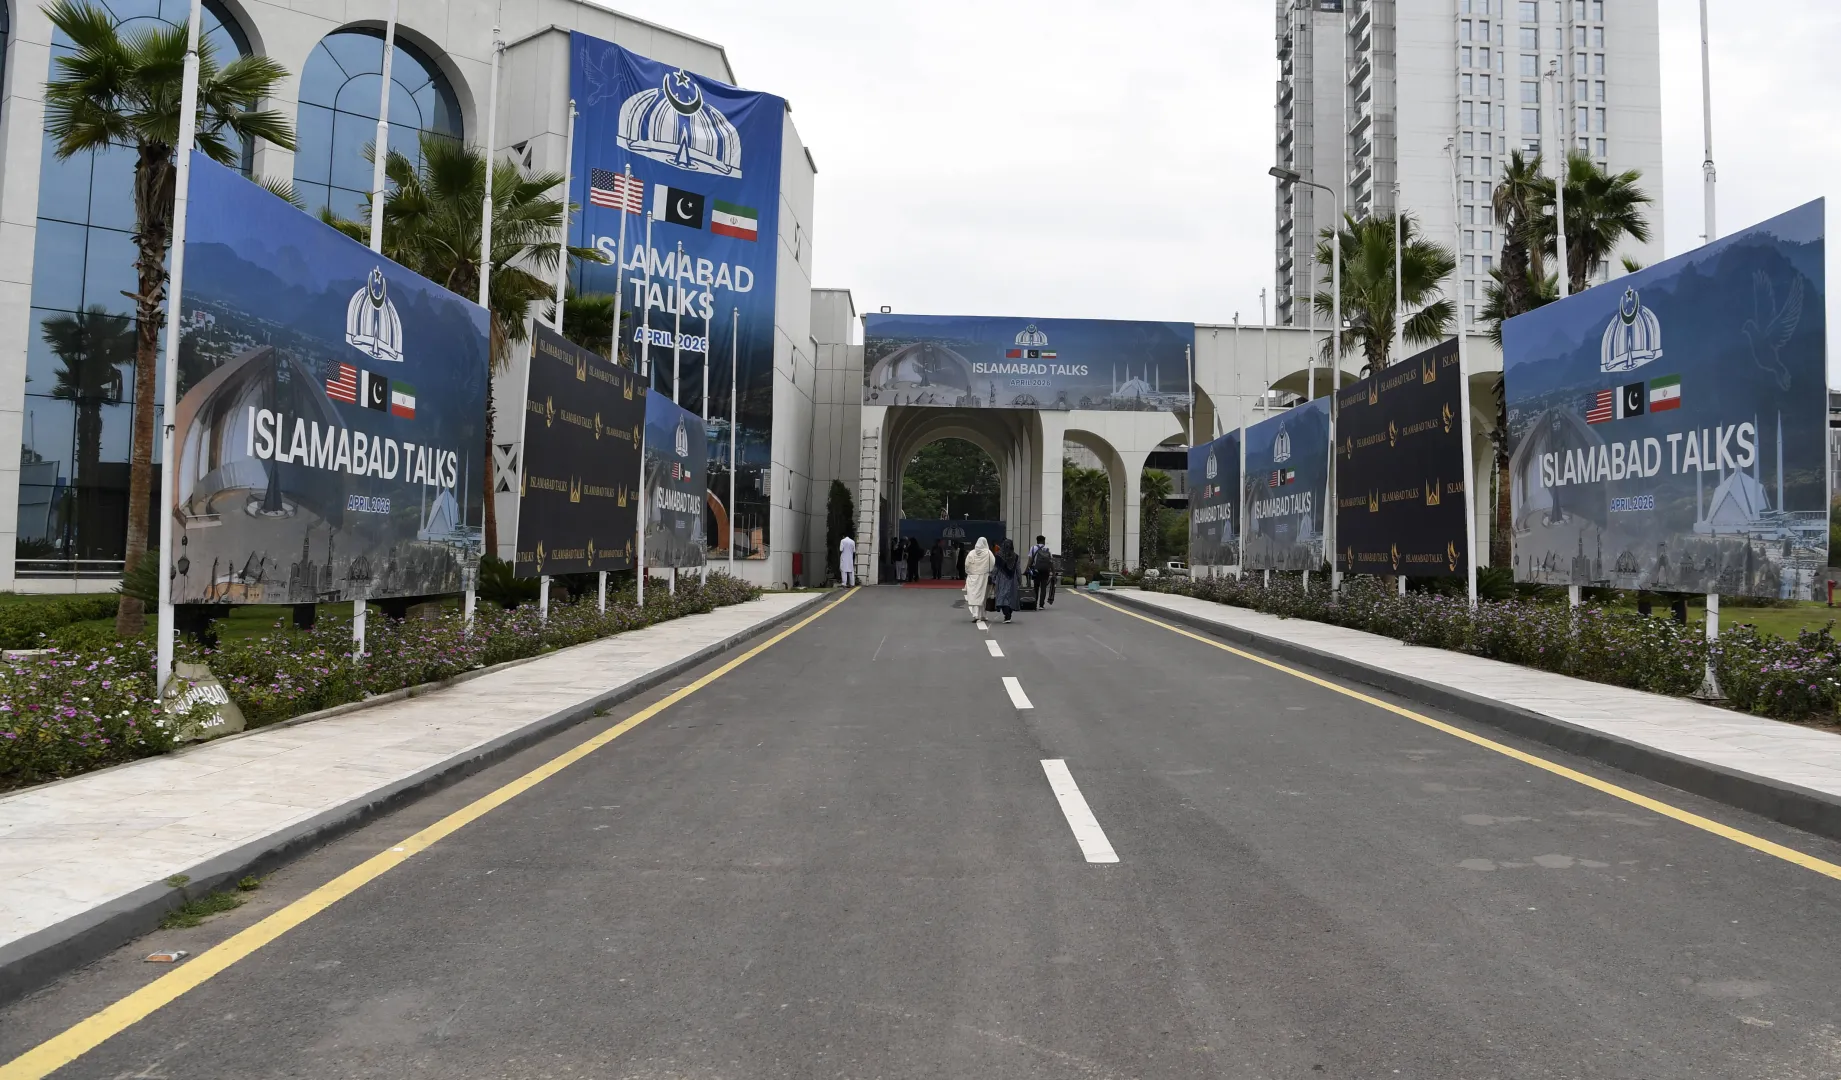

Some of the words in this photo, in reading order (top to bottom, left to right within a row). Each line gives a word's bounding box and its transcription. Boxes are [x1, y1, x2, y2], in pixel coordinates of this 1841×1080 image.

[630, 277, 714, 320] TALKS
[673, 335, 709, 353] 2026
[973, 362, 1046, 374] ISLAMABAD
[1050, 364, 1088, 376] TALKS
[247, 406, 398, 480] ISLAMABAD
[403, 443, 457, 488] TALKS
[1539, 437, 1662, 488] ISLAMABAD
[1666, 422, 1756, 475] TALKS
[347, 494, 370, 512] APRIL
[371, 496, 390, 514] 2026
[656, 486, 686, 512] ISLAMABAD
[687, 494, 700, 514] TALKS
[1254, 494, 1290, 520] ISLAMABAD
[1290, 492, 1312, 514] TALKS
[1610, 498, 1632, 512] APRIL
[1632, 494, 1654, 511] 2026
[1195, 505, 1216, 524] ISLAMABAD
